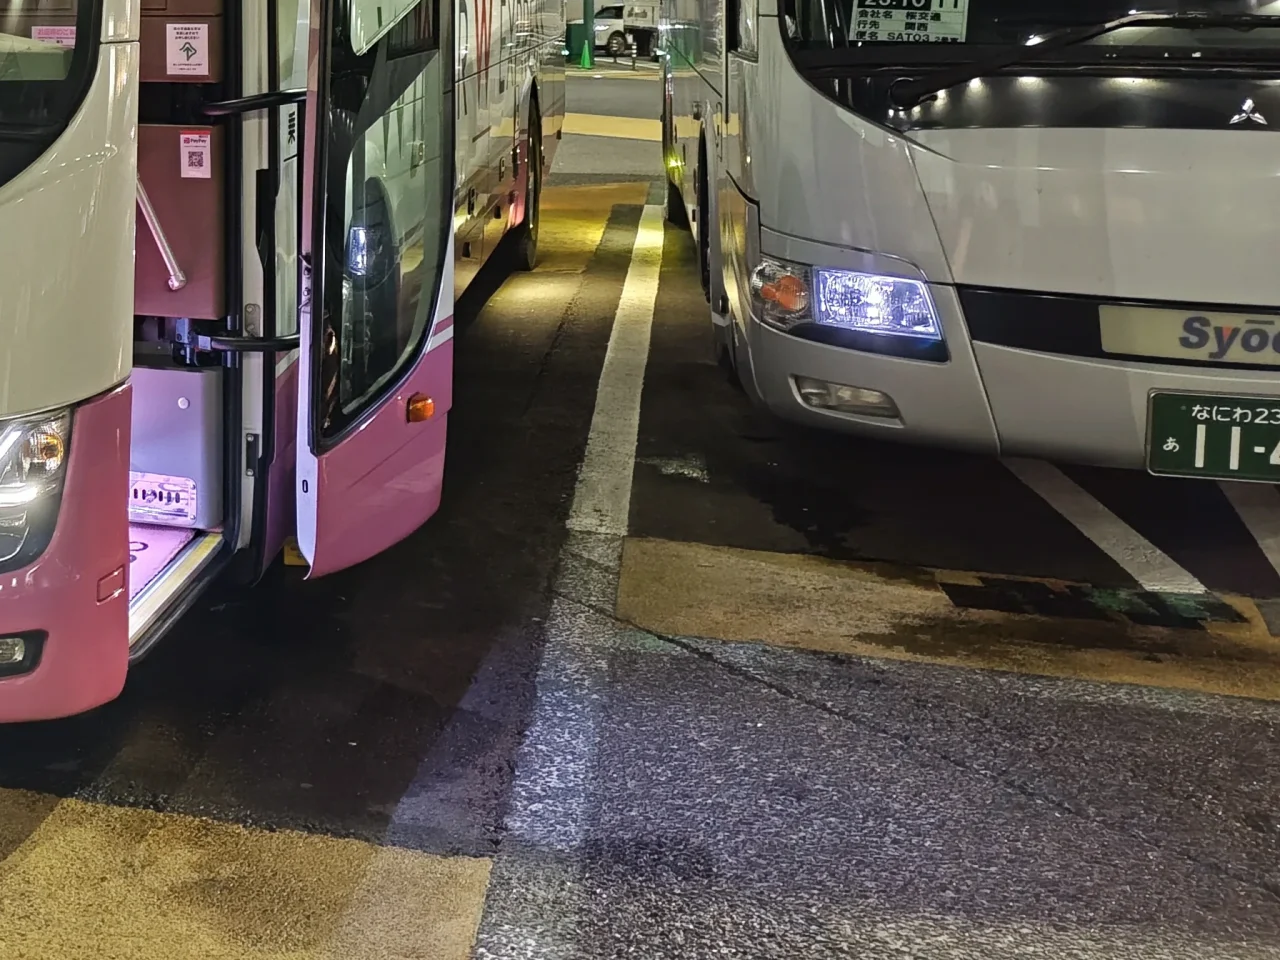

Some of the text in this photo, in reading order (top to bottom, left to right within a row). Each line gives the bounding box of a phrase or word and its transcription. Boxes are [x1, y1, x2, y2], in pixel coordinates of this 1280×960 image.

[858, 9, 893, 19] 会社名
[857, 20, 880, 29] 行先
[1163, 437, 1180, 453] あ
